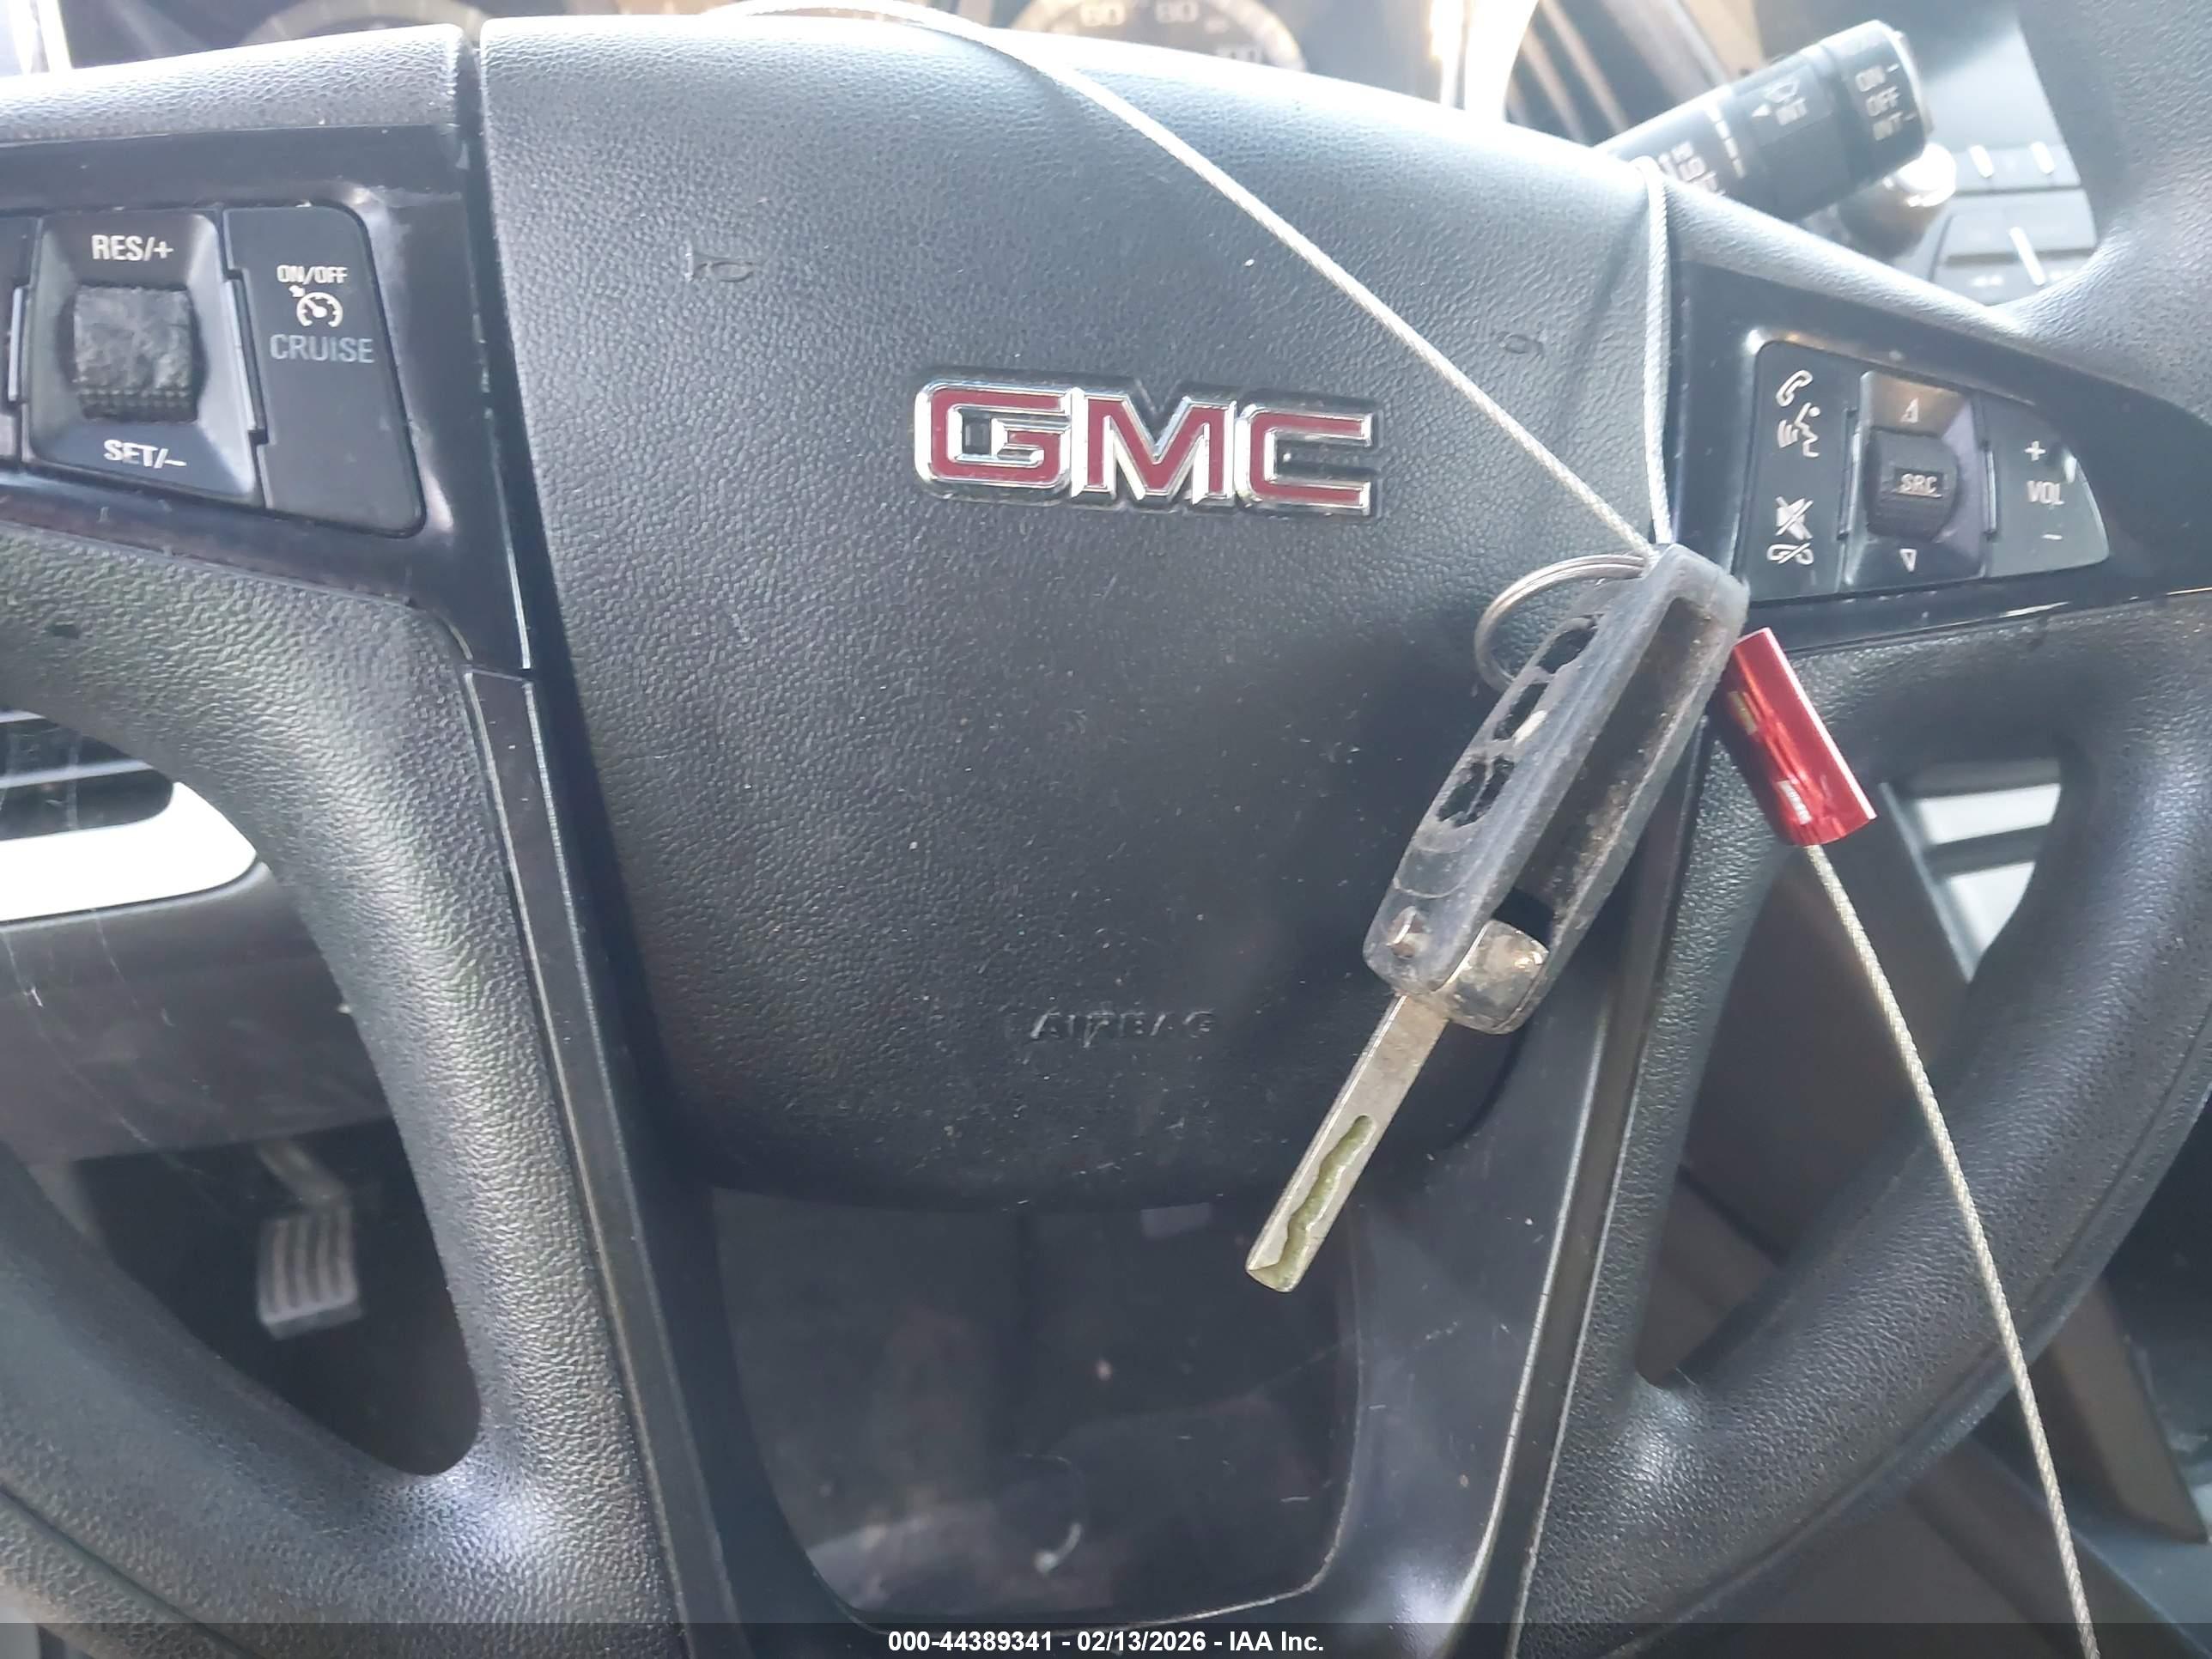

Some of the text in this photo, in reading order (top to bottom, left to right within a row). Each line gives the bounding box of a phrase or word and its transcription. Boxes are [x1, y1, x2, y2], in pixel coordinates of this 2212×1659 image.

[1866, 86, 1900, 117] OFF
[91, 234, 174, 261] RES/+
[276, 264, 348, 284] ON/OFF
[270, 334, 376, 364] CRUISE
[914, 379, 1373, 515] GMC
[1899, 473, 1939, 495] SRC
[2027, 480, 2065, 506] VOL
